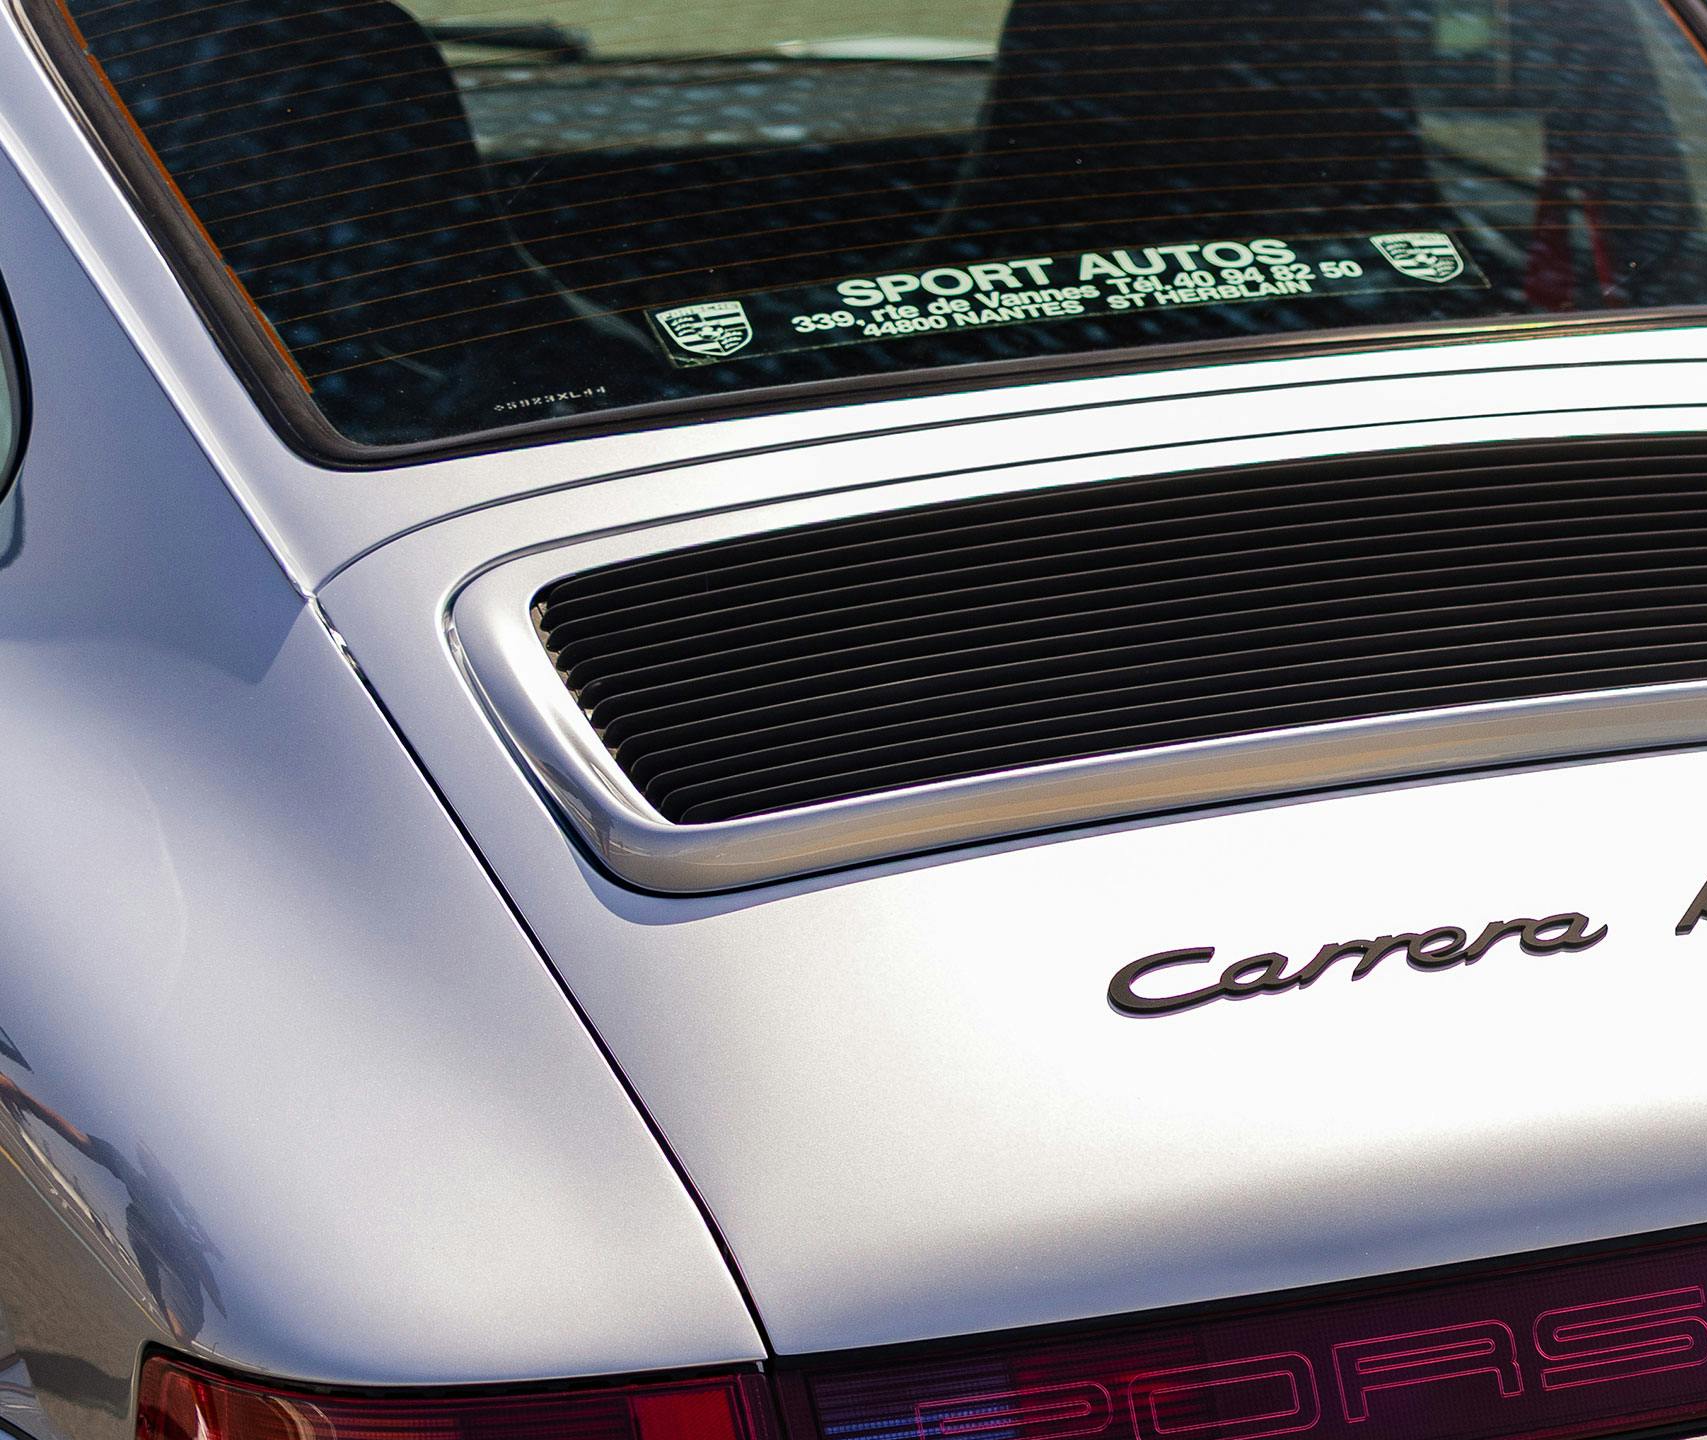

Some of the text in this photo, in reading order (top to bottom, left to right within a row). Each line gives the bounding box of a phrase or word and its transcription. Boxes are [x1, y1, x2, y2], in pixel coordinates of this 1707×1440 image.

[836, 238, 1297, 307] SPORT AUTOS
[871, 303, 920, 323] rte
[927, 297, 972, 315] de
[974, 284, 1101, 310] Vannes
[1220, 266, 1266, 286] 94
[1269, 263, 1316, 282] 82
[1318, 260, 1364, 279] 50
[862, 279, 1313, 338] 44800 NANTES ST HERBLAIN
[1105, 910, 1609, 1019] Carrera
